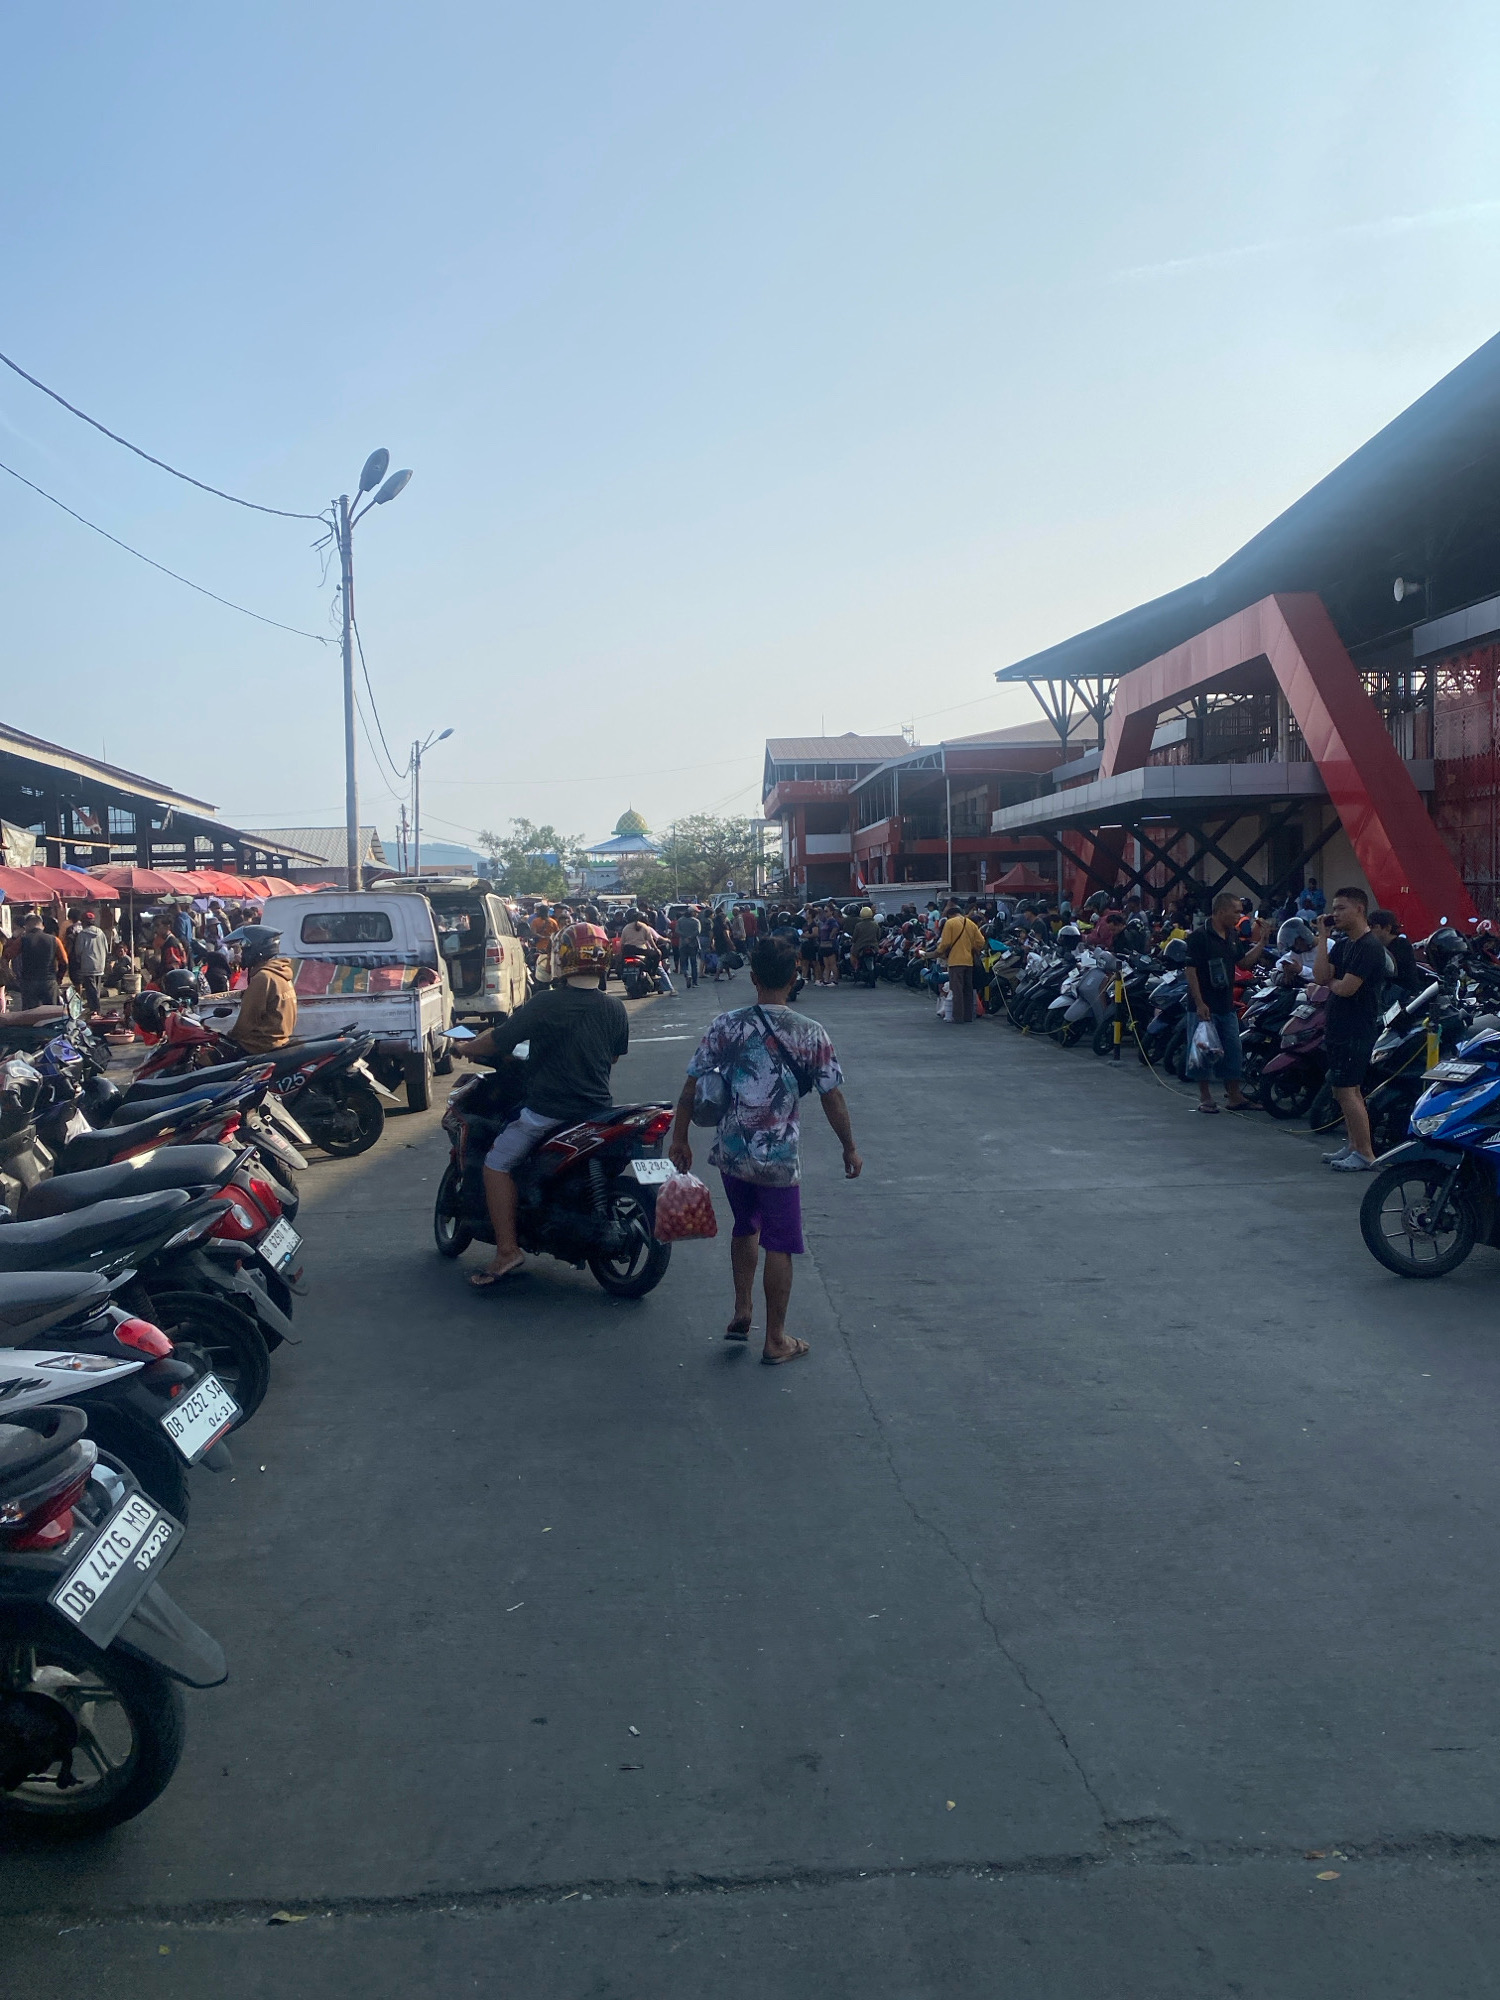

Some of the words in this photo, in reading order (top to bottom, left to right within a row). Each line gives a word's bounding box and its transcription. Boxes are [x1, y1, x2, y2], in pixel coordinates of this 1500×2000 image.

[1453, 1127, 1478, 1139] HONDA
[634, 1161, 646, 1173] DB
[261, 1244, 273, 1259] DB
[166, 1416, 185, 1439] DB
[181, 1392, 209, 1424] 2252
[205, 1380, 224, 1399] SA
[62, 1532, 84, 1556] HONDA
[62, 1580, 96, 1616] DB
[89, 1530, 131, 1581] 4476
